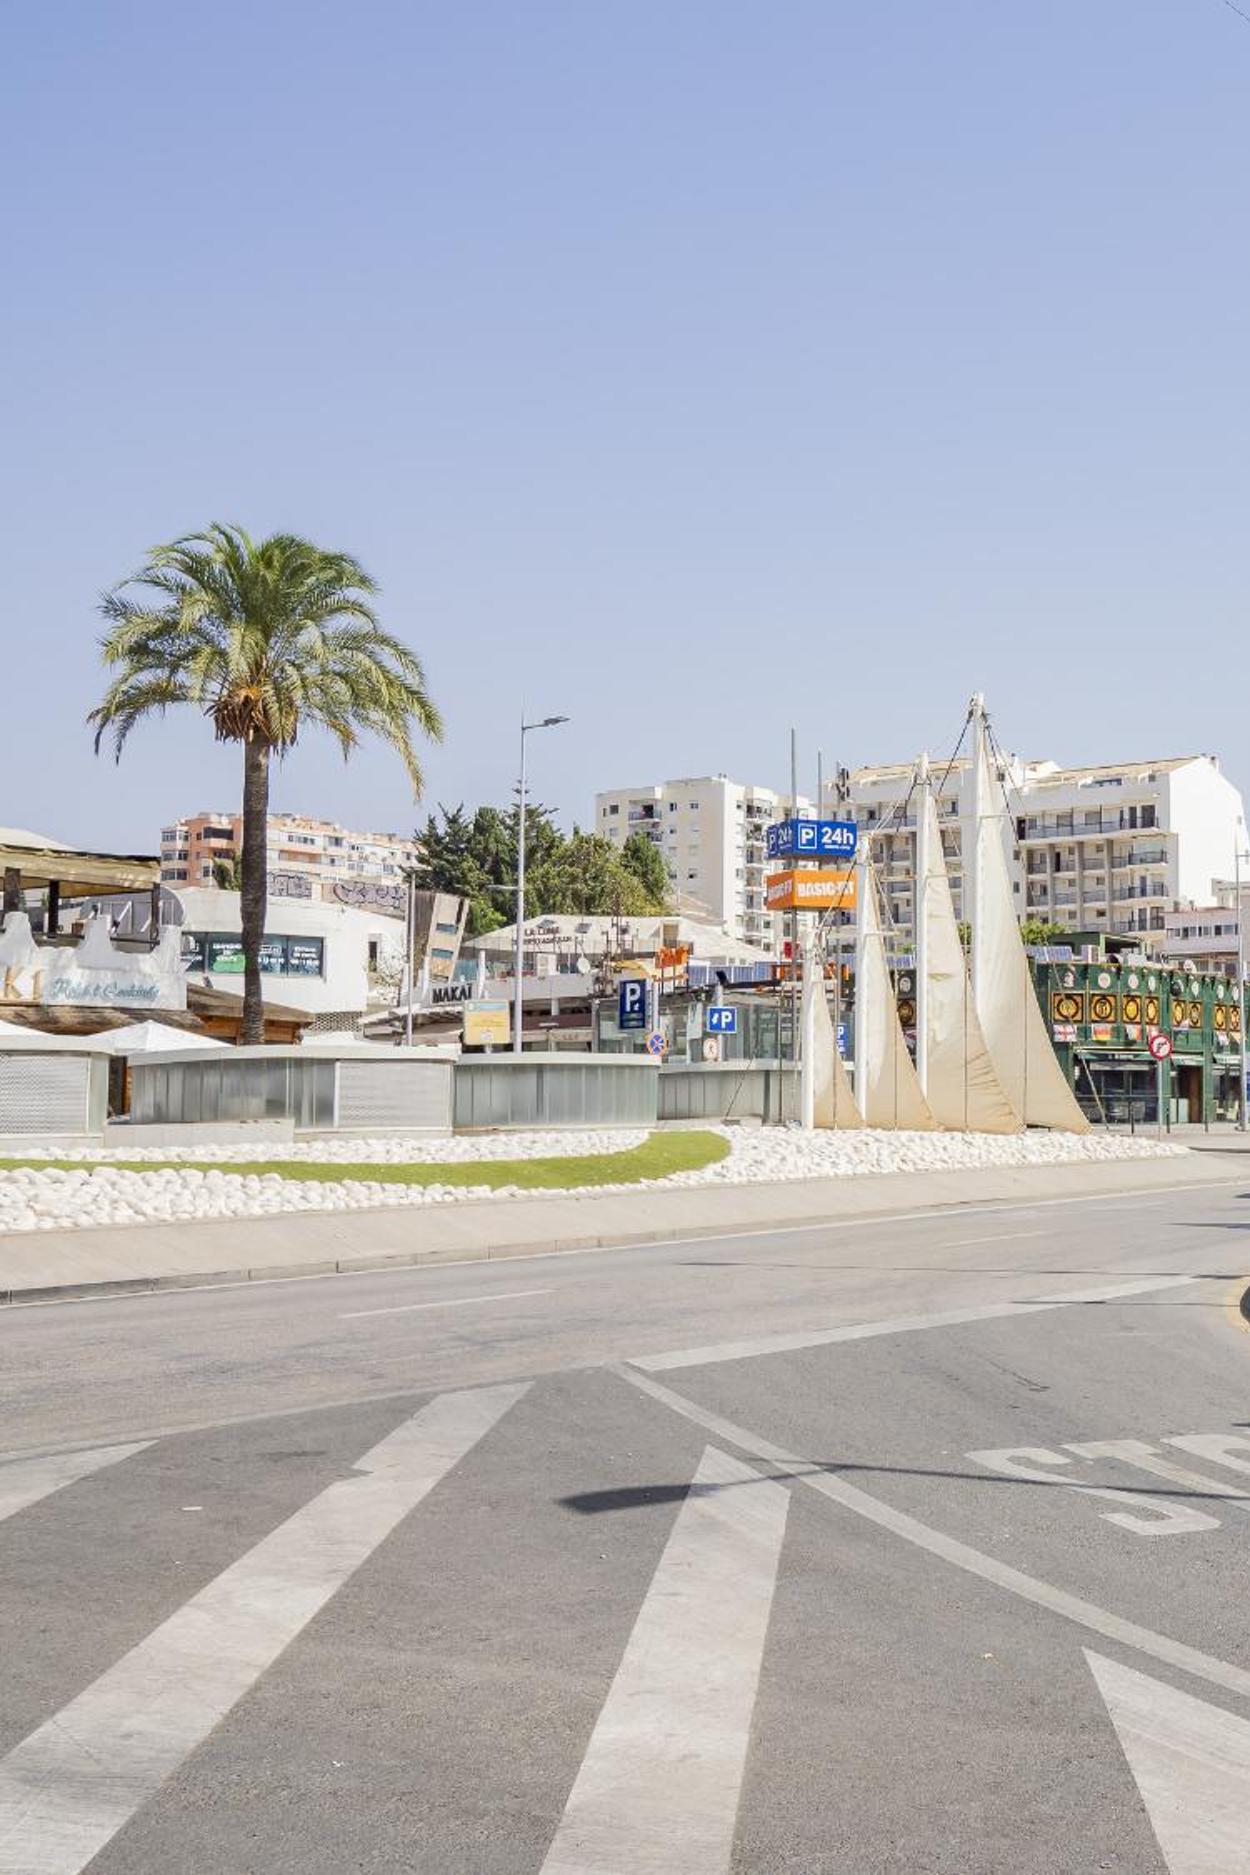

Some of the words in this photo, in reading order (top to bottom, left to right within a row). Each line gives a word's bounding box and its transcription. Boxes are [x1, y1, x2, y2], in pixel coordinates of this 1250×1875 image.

[801, 828, 814, 844] P
[821, 826, 855, 845] 24h
[625, 982, 641, 1012] P
[721, 1011, 732, 1028] P
